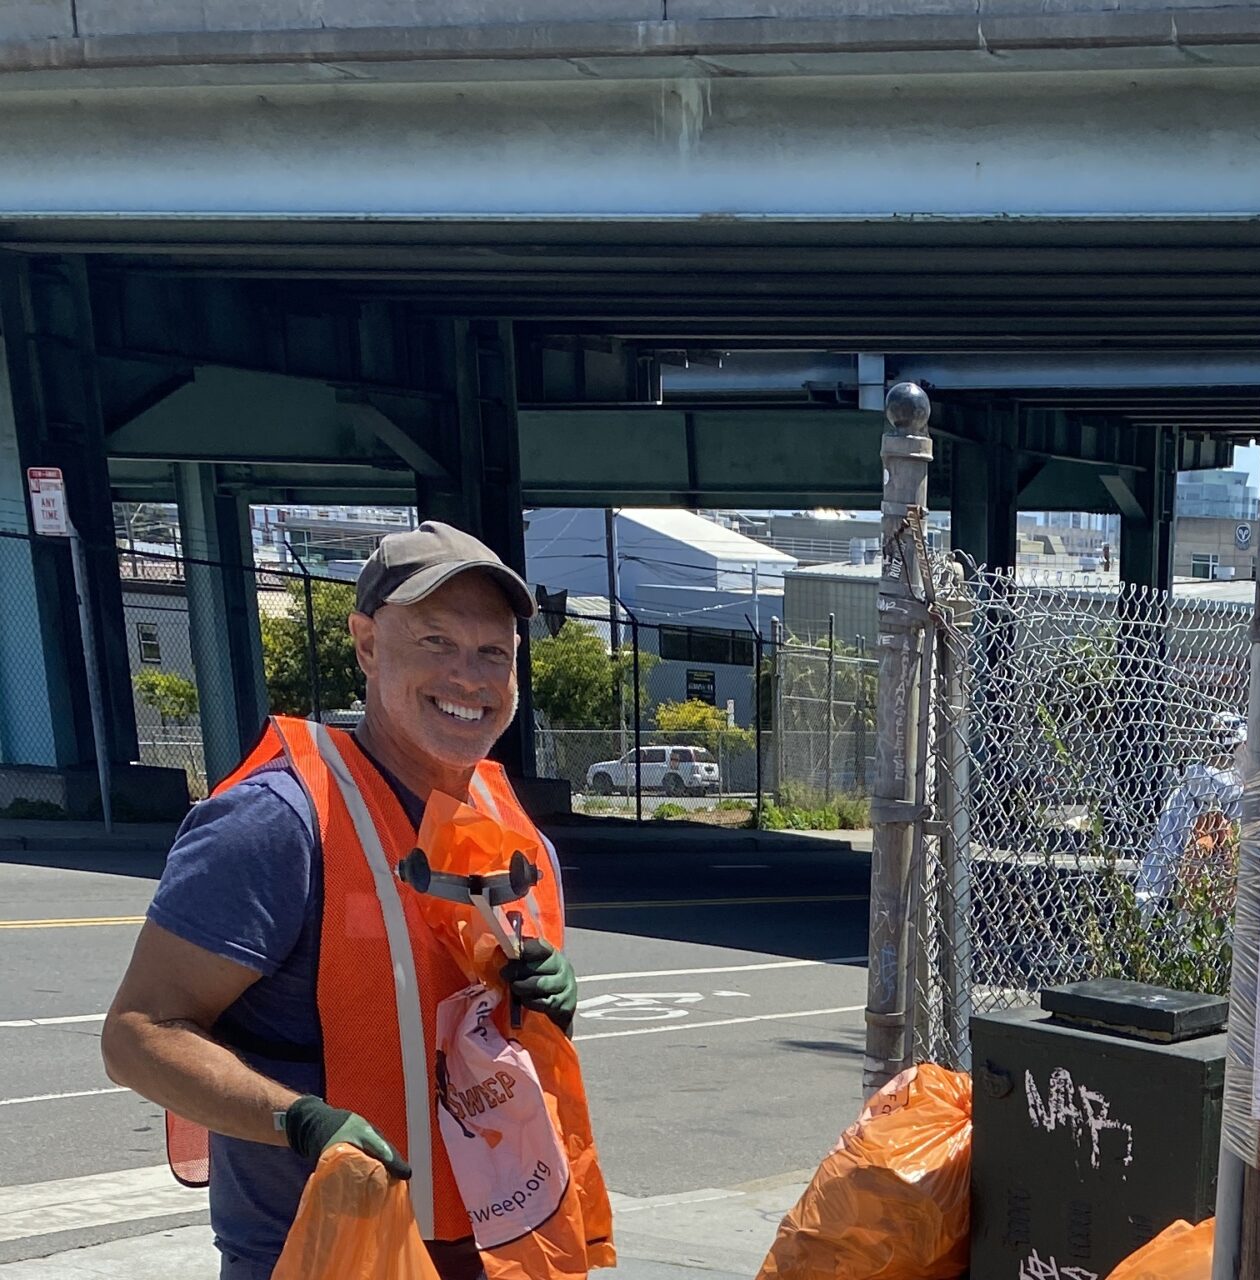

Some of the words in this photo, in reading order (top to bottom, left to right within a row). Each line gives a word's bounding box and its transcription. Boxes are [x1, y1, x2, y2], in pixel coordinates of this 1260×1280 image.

[41, 498, 56, 508] ANY
[41, 510, 59, 521] TIME
[446, 1070, 516, 1120] SWEEP
